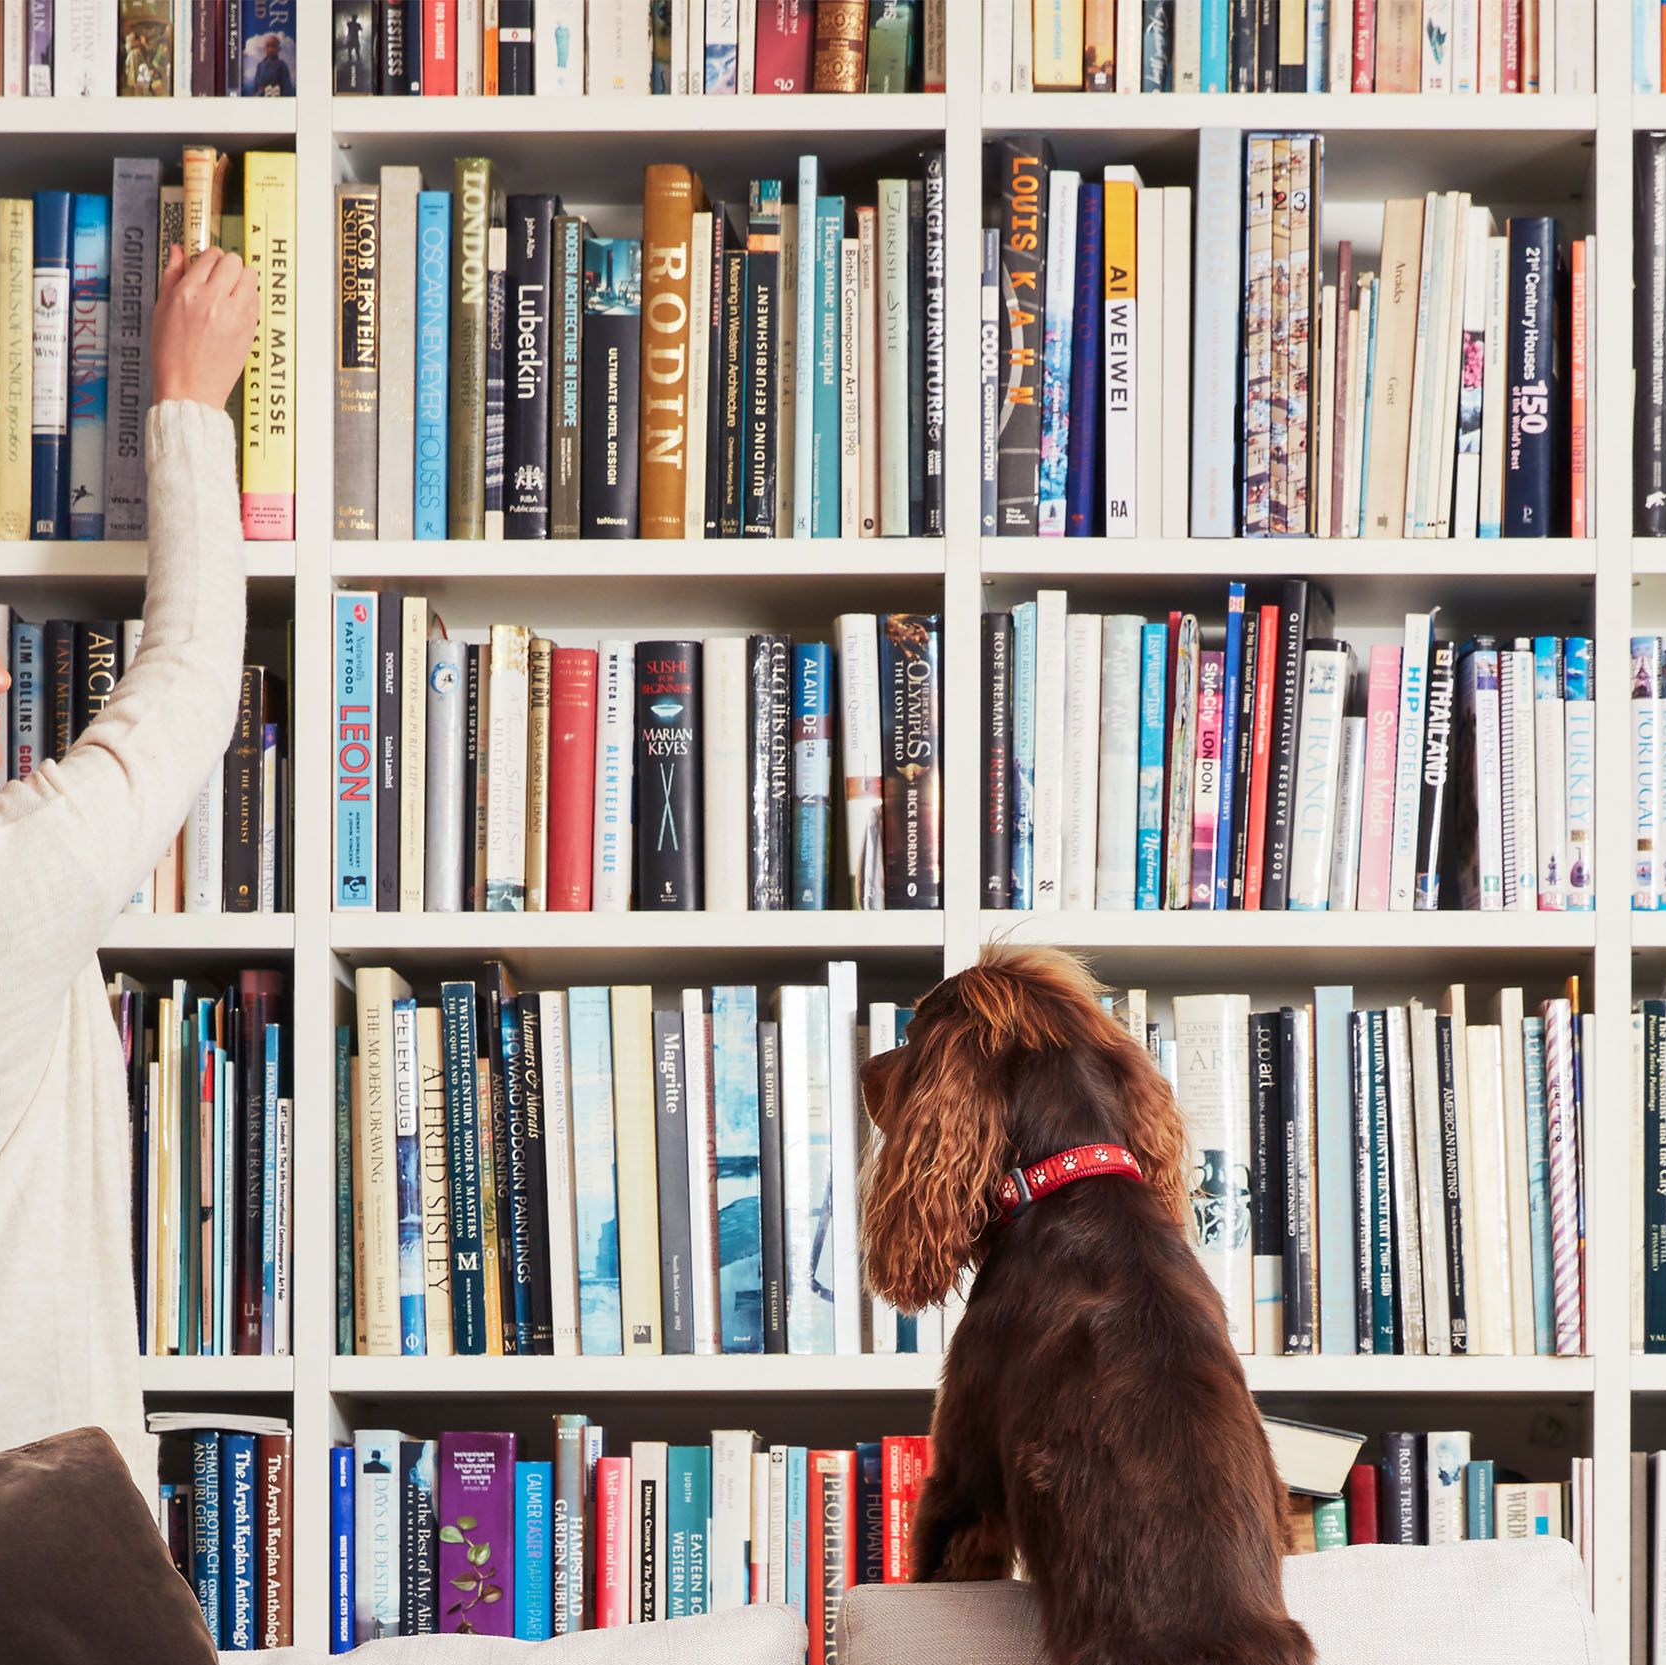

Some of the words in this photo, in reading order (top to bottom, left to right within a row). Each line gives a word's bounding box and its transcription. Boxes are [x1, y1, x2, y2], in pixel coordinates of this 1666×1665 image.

[387, 9, 403, 76] RESTLESS
[927, 178, 943, 278] ENGLISH
[1011, 156, 1038, 251] LOUIS
[343, 209, 356, 302] SCULPTOR
[355, 202, 374, 270] JACOB
[462, 170, 483, 304] LONDON
[1525, 247, 1541, 271] 21st
[122, 227, 144, 337] CONCRETE
[271, 239, 287, 315] HENRI
[845, 249, 856, 284] British
[1110, 266, 1127, 292] AI
[358, 279, 374, 362] EPSTEIN
[1522, 272, 1539, 328] Century
[73, 262, 98, 419] HOKUSAI
[517, 285, 543, 399] Lubetkin
[646, 242, 687, 470] RODIN
[755, 285, 769, 415] REFURBISHMENT
[842, 288, 856, 373] Contemporary
[927, 288, 943, 425] FURNITURE
[982, 324, 998, 383] COOL
[1523, 329, 1540, 380] Houses
[270, 329, 285, 436] MATISSE
[608, 348, 618, 402] ULTIMATE
[845, 377, 856, 395] Art
[1110, 305, 1128, 413] WEIWEI
[119, 346, 141, 458] BUILDINGS
[608, 405, 618, 438] HOTEL
[845, 399, 856, 456] 1910-1990
[1521, 380, 1548, 434] 150
[753, 423, 767, 496] BUILDING
[983, 384, 996, 481] CONSTRUCTION
[607, 442, 617, 485] DESIGN
[19, 636, 32, 664] JIM
[346, 622, 354, 654] FAST
[993, 632, 1004, 668] ROSE
[241, 672, 253, 705] CALEB
[346, 659, 354, 694] FOOD
[608, 654, 619, 699] MONICA
[804, 658, 817, 707] ALAIN
[895, 660, 903, 684] THE
[1203, 662, 1217, 722] StyleCity
[1279, 613, 1300, 756] QUINTESSENTIALLY
[1407, 667, 1420, 712] HIP
[19, 672, 32, 731] COLLINS
[241, 709, 251, 738] CARR
[607, 707, 618, 723] ALI
[803, 715, 816, 734] DE
[895, 690, 903, 720] LOST
[993, 673, 1004, 737] TREMAIN
[340, 705, 369, 801] LEON
[642, 728, 693, 741] MARIAN
[648, 741, 688, 756] KEYES
[895, 726, 903, 761] HERO
[1401, 718, 1420, 791] HOTELS
[241, 769, 249, 789] THE
[605, 745, 619, 823] ALENTEJO
[1201, 731, 1215, 793] LONDON
[240, 794, 249, 843] ALIENIST
[908, 790, 917, 817] RICK
[1275, 765, 1288, 826] RESERVE
[603, 834, 619, 872] BLUE
[908, 822, 917, 876] RIORDAN
[1272, 843, 1284, 880] 2008
[459, 997, 473, 1125] TWENTIETH-CENTURY
[660, 1033, 681, 1113] Magritte
[764, 1036, 773, 1069] MARK
[765, 1073, 775, 1117] ROTHKO
[423, 1065, 447, 1183] ALFRED
[464, 1129, 475, 1182] MODERN
[466, 1185, 477, 1239] MASTERS
[426, 1196, 450, 1295] SISLEY
[235, 1450, 250, 1479] The
[268, 1455, 280, 1483] The
[233, 1481, 250, 1524] Aryeh
[267, 1484, 281, 1525] Aryeh
[418, 1485, 431, 1500] To
[418, 1503, 430, 1525] the
[824, 1476, 843, 1561] PEOPLE
[233, 1526, 250, 1575] Kaplan
[265, 1527, 280, 1576] Kaplan
[417, 1529, 431, 1557] Best
[554, 1500, 567, 1566] GARDEN
[414, 1578, 430, 1601] My
[418, 1561, 431, 1574] of
[570, 1517, 583, 1616] HAMPSTEAD
[825, 1566, 843, 1591] IN
[233, 1577, 250, 1648] Anthology
[265, 1579, 280, 1648] Anthology
[554, 1572, 567, 1633] SUBURB
